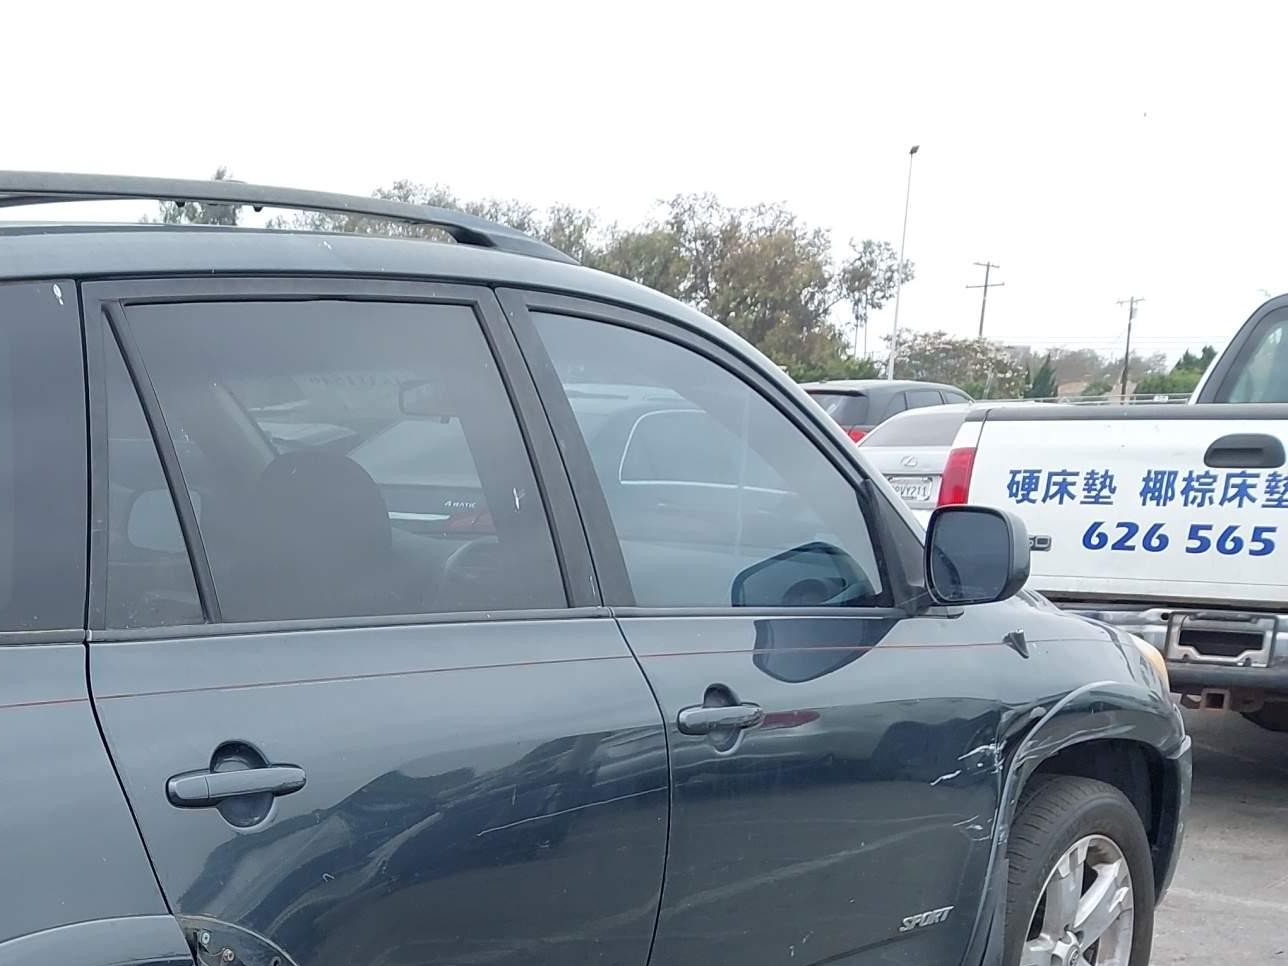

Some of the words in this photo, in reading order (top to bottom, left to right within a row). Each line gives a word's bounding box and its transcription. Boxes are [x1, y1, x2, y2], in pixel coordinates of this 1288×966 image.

[1007, 469, 1117, 505] 硬床墊
[1082, 521, 1170, 552] 626
[1185, 524, 1279, 556] 565
[899, 905, 954, 932] SPORT
